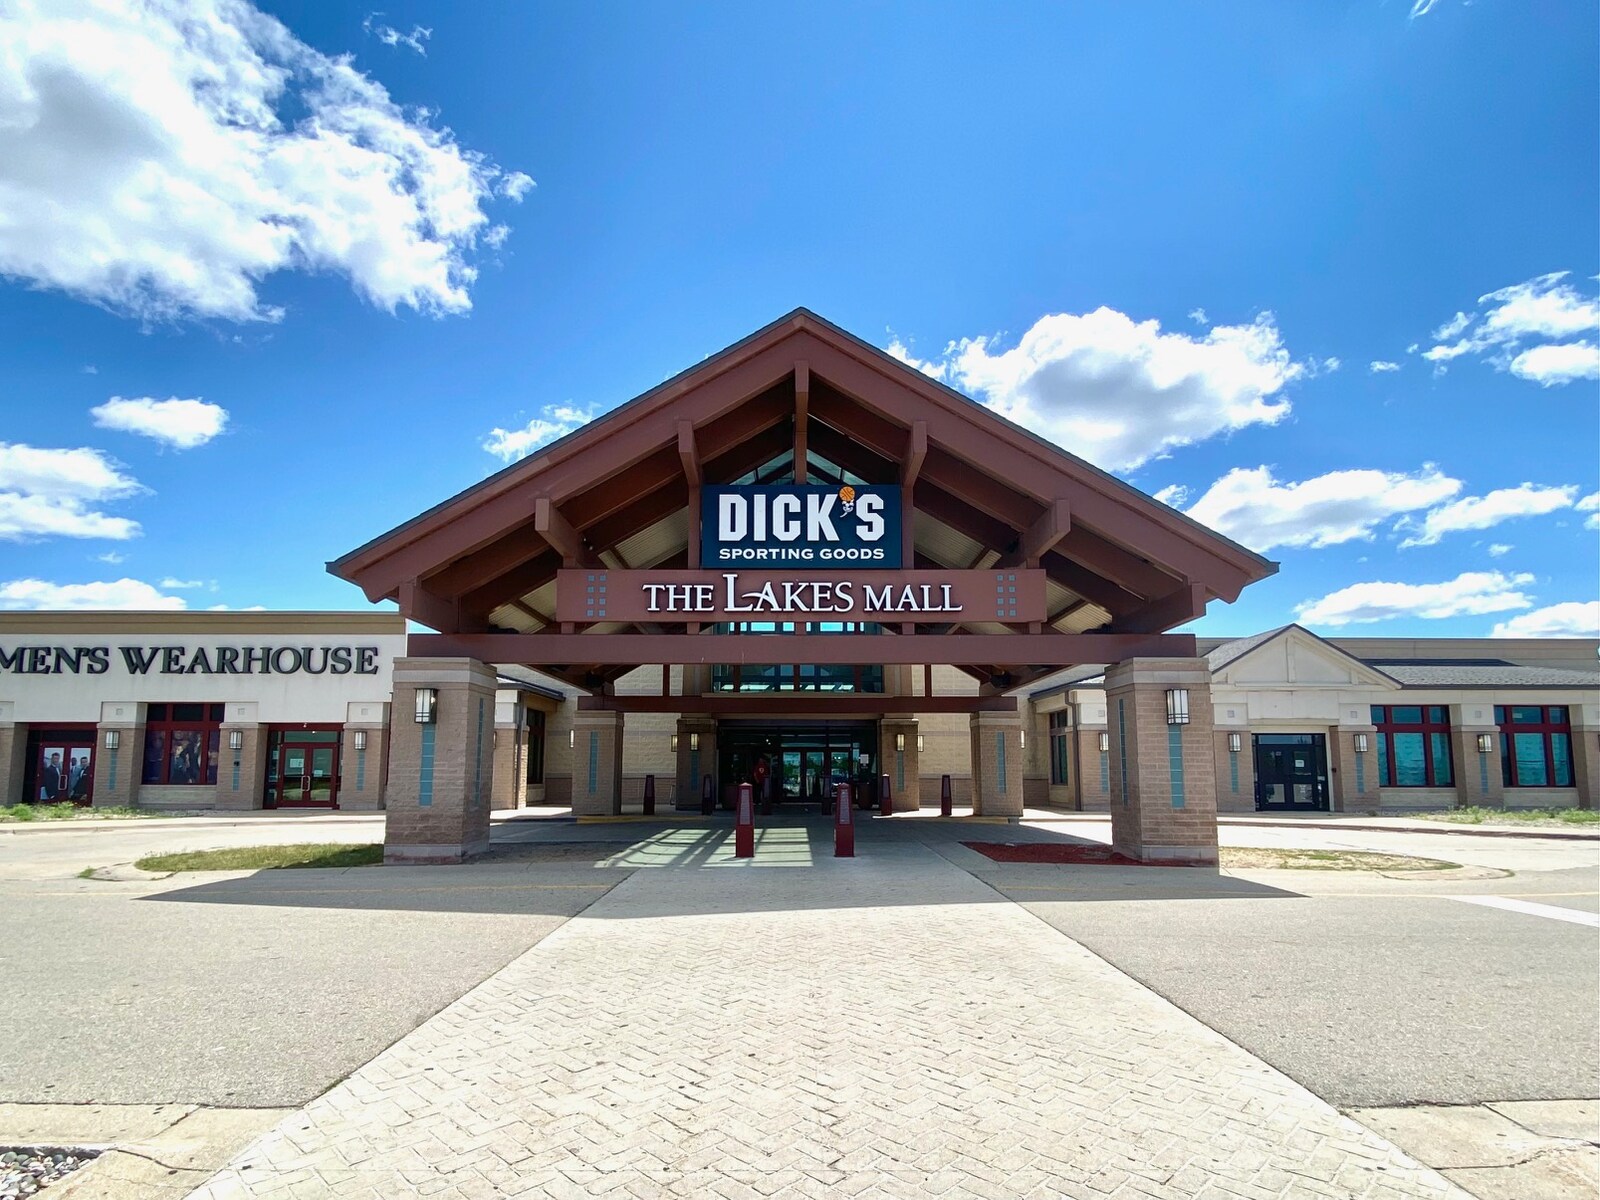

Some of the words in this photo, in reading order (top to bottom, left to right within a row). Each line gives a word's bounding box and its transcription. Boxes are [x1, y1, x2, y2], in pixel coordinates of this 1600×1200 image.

[718, 487, 885, 542] DICK'S
[718, 548, 815, 560] SPORTING
[819, 548, 886, 560] GOODS
[642, 584, 715, 612] THE
[722, 573, 855, 613] LAKES
[862, 584, 963, 612] MALL
[0, 646, 110, 675] MEN'S
[118, 646, 379, 675] WEARHOUSE
